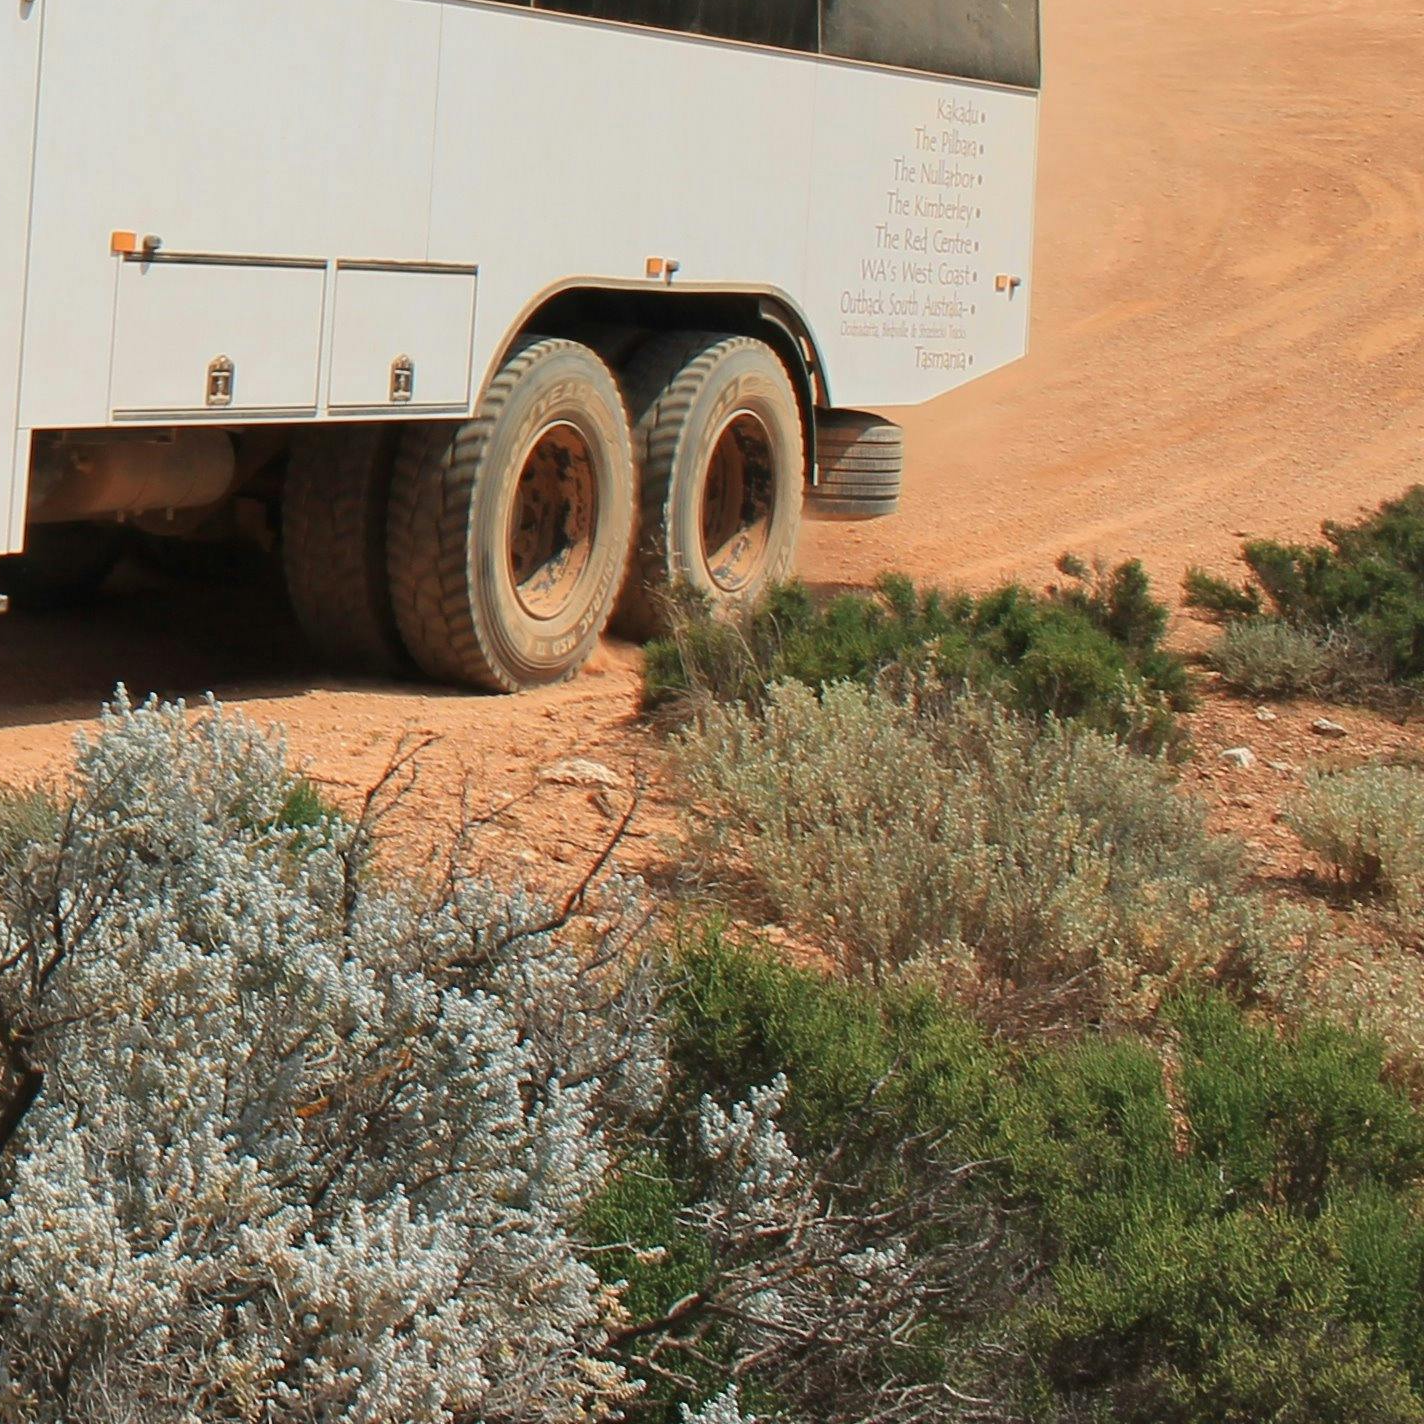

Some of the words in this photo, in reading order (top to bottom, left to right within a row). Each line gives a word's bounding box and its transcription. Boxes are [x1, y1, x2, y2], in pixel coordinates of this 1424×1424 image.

[937, 97, 979, 126] Kakadu
[915, 124, 937, 153] The
[941, 128, 977, 159] Pilbara
[894, 154, 917, 184] The
[920, 159, 976, 189] Nullarbor
[887, 188, 910, 217] The
[915, 192, 974, 228] Kimberley
[875, 221, 900, 251] The
[904, 227, 929, 255] Red
[932, 229, 973, 255] Centre
[861, 258, 898, 283] WA's
[901, 260, 934, 285] West
[938, 261, 971, 286] Coast
[840, 289, 885, 317] Outback
[888, 290, 919, 317] South
[914, 345, 967, 371] Tasmania
